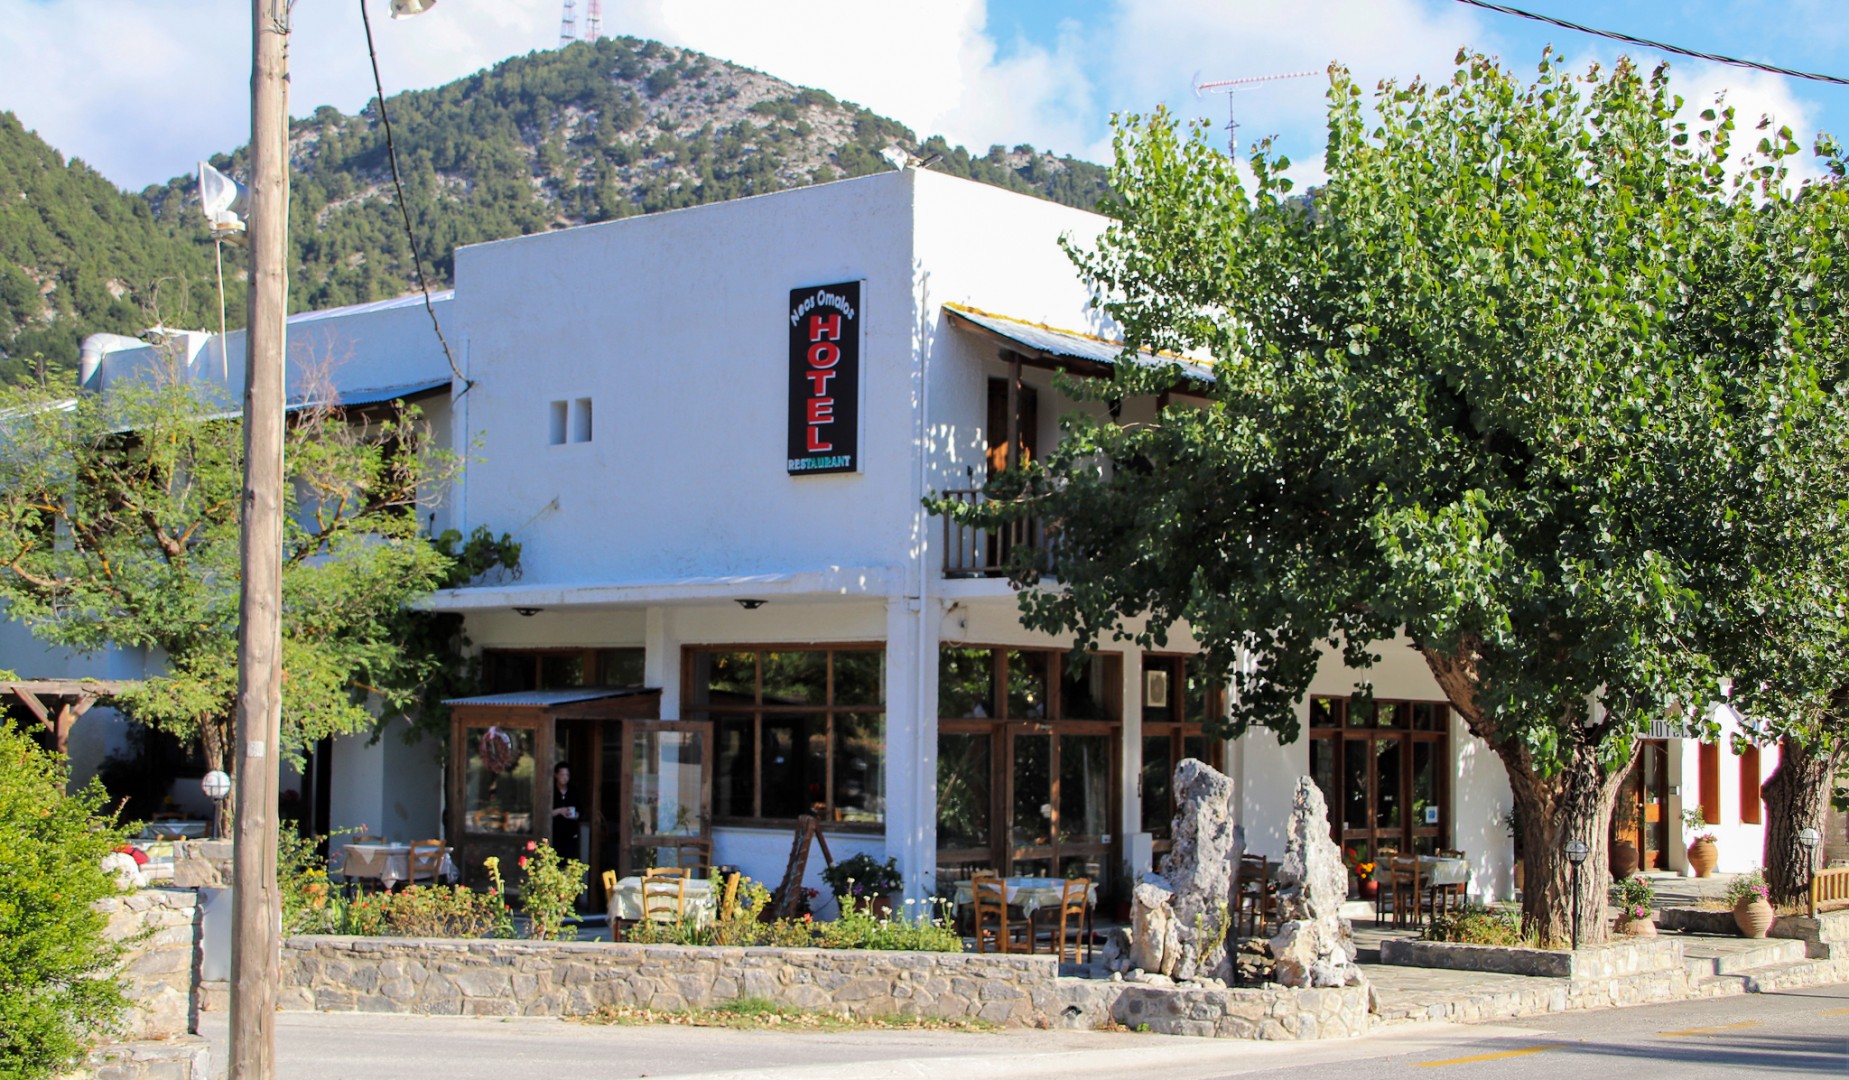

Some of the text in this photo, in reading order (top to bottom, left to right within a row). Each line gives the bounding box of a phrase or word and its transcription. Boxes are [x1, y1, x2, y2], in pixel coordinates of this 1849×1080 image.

[790, 289, 855, 327] Neos Omalos
[806, 314, 841, 452] HOTEL
[788, 455, 851, 470] RESTAURANT
